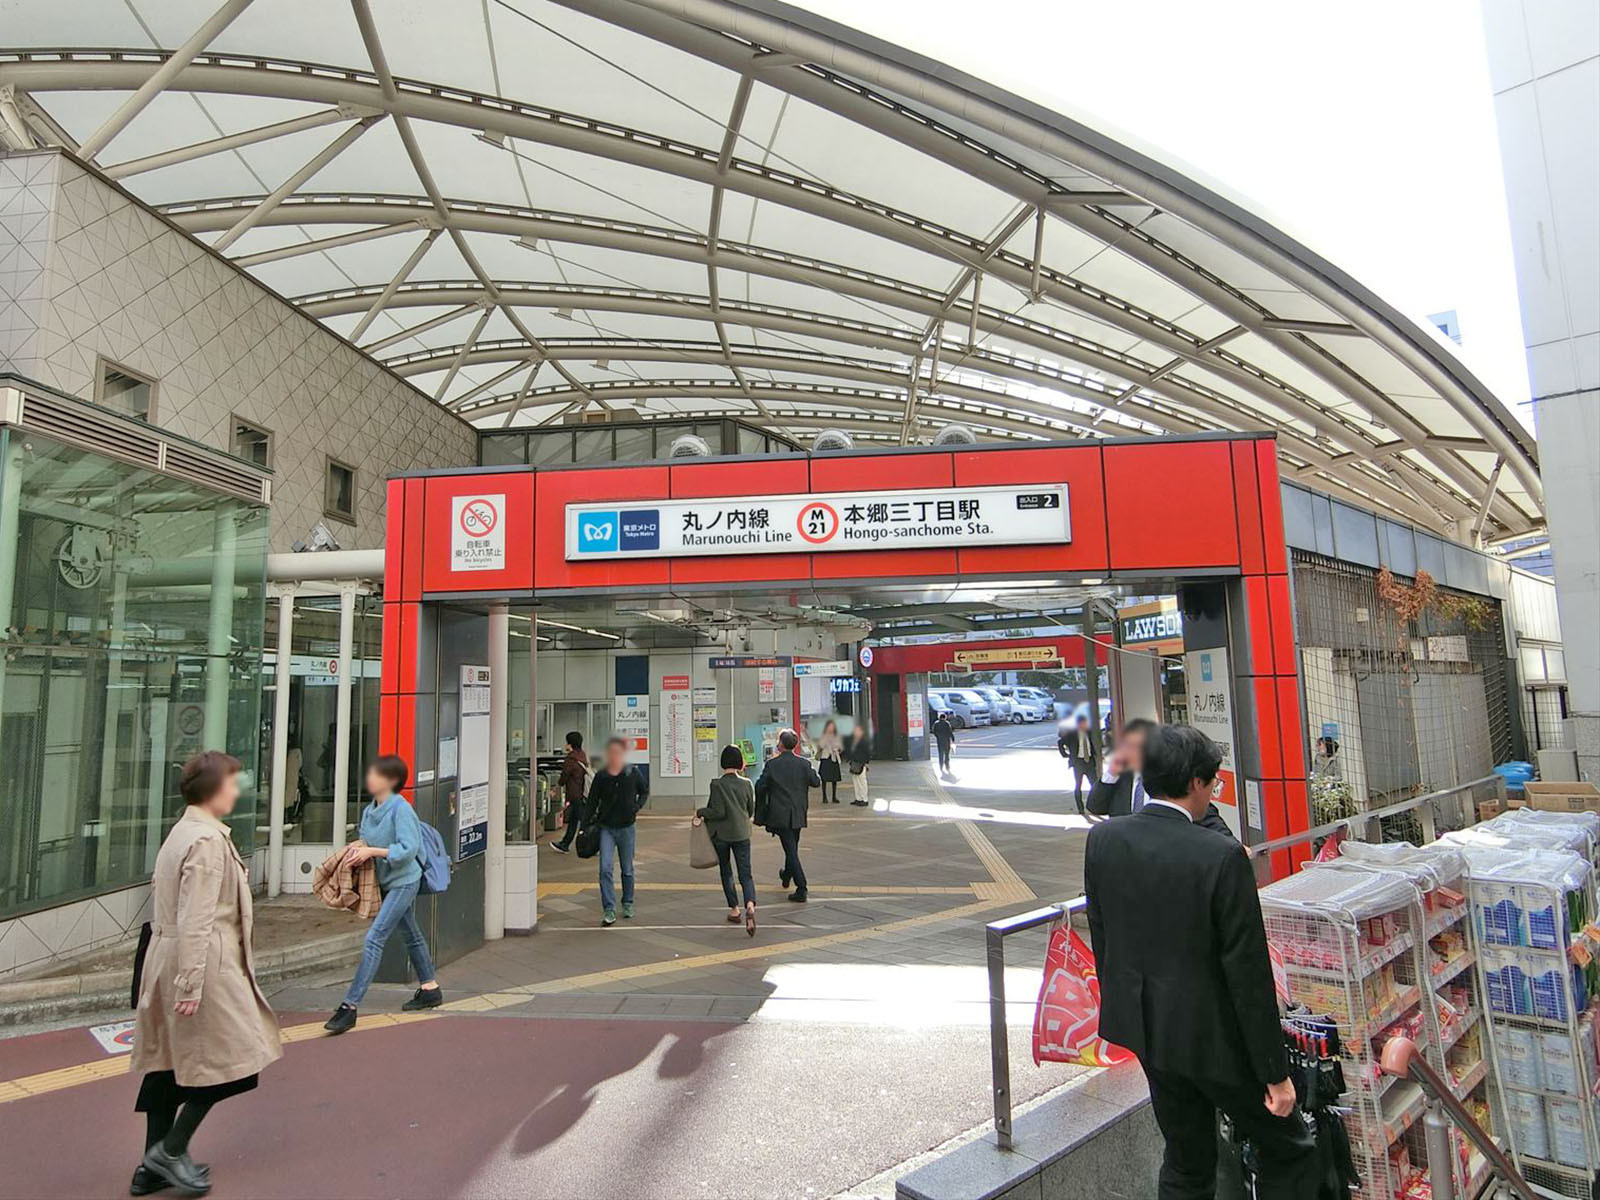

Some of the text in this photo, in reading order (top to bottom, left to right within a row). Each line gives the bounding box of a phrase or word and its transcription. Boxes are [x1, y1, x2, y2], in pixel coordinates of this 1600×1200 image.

[1043, 494, 1053, 508] 2
[810, 509, 824, 521] M
[843, 499, 981, 525] 本郷三丁目駅
[682, 508, 770, 531] 丸ノ内線
[623, 524, 656, 532] 東京メトロ
[808, 522, 826, 535] 21
[843, 522, 994, 542] Hongo-sanchome Sta.
[466, 540, 491, 549] 自転車
[682, 530, 792, 546] Marunouchi Line
[455, 548, 502, 558] 乗り入れ禁止
[1194, 692, 1226, 712] 丸ノ内線
